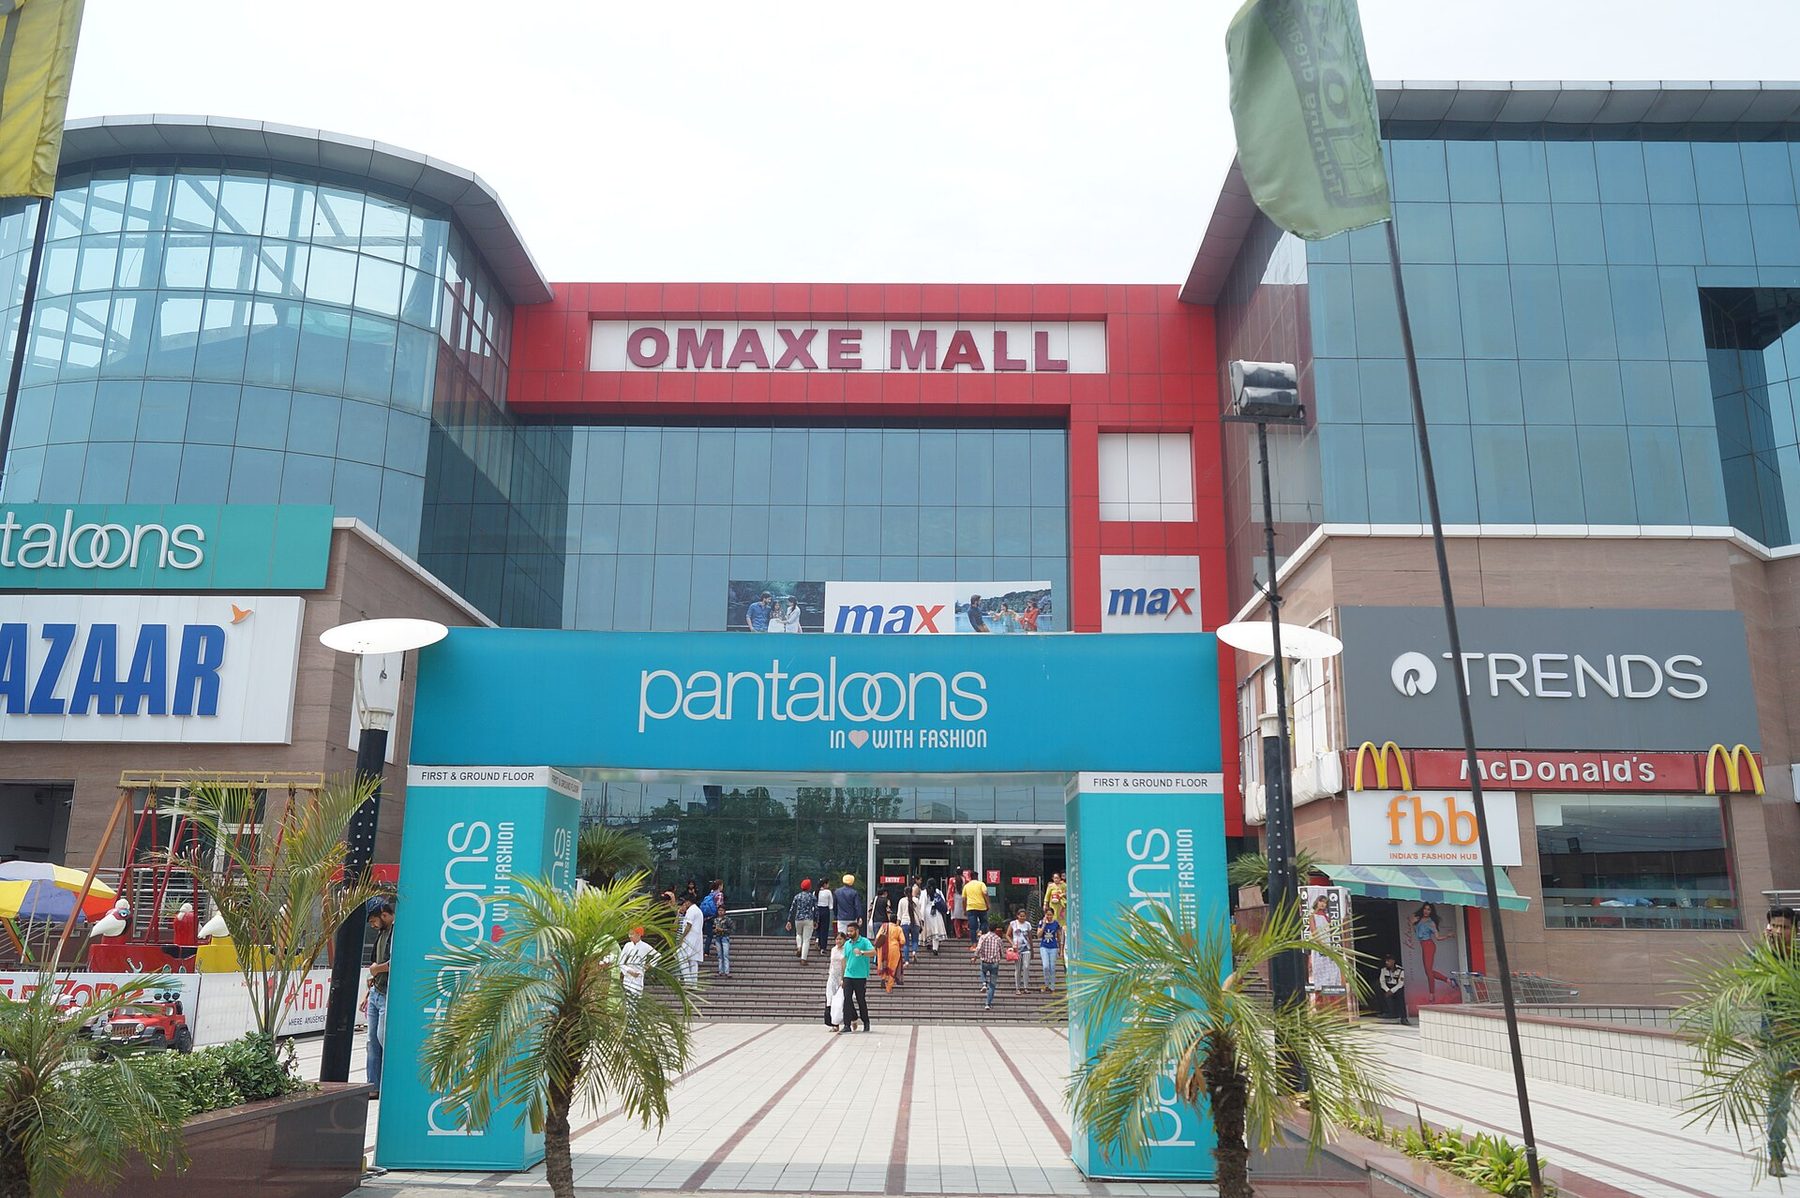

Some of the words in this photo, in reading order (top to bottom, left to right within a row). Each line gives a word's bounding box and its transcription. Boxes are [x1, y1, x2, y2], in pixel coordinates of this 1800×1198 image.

[626, 327, 862, 370] OMAXE
[890, 328, 1068, 372] MALL
[0, 509, 206, 570] taloons
[834, 603, 946, 633] max
[1106, 586, 1196, 620] max
[1442, 651, 1709, 700] TRENDS
[638, 656, 988, 734] pantaloons
[830, 730, 845, 749] IN
[872, 729, 913, 749] WITH
[919, 728, 988, 749] FASHION
[421, 771, 448, 781] FIRST
[450, 771, 457, 781] &
[459, 771, 500, 781] GROUND
[502, 772, 534, 781] FLOOR
[1093, 778, 1120, 787] FIRST
[1123, 778, 1129, 787] &
[1131, 778, 1173, 788] GROUND
[1175, 779, 1208, 788] FLOOR
[1459, 756, 1657, 783] McDonald's
[1386, 793, 1480, 846] fbb
[495, 822, 514, 881] FASHION
[1176, 828, 1195, 888] FASHION
[1389, 852, 1419, 860] INDIA'S
[491, 885, 511, 922] WIH
